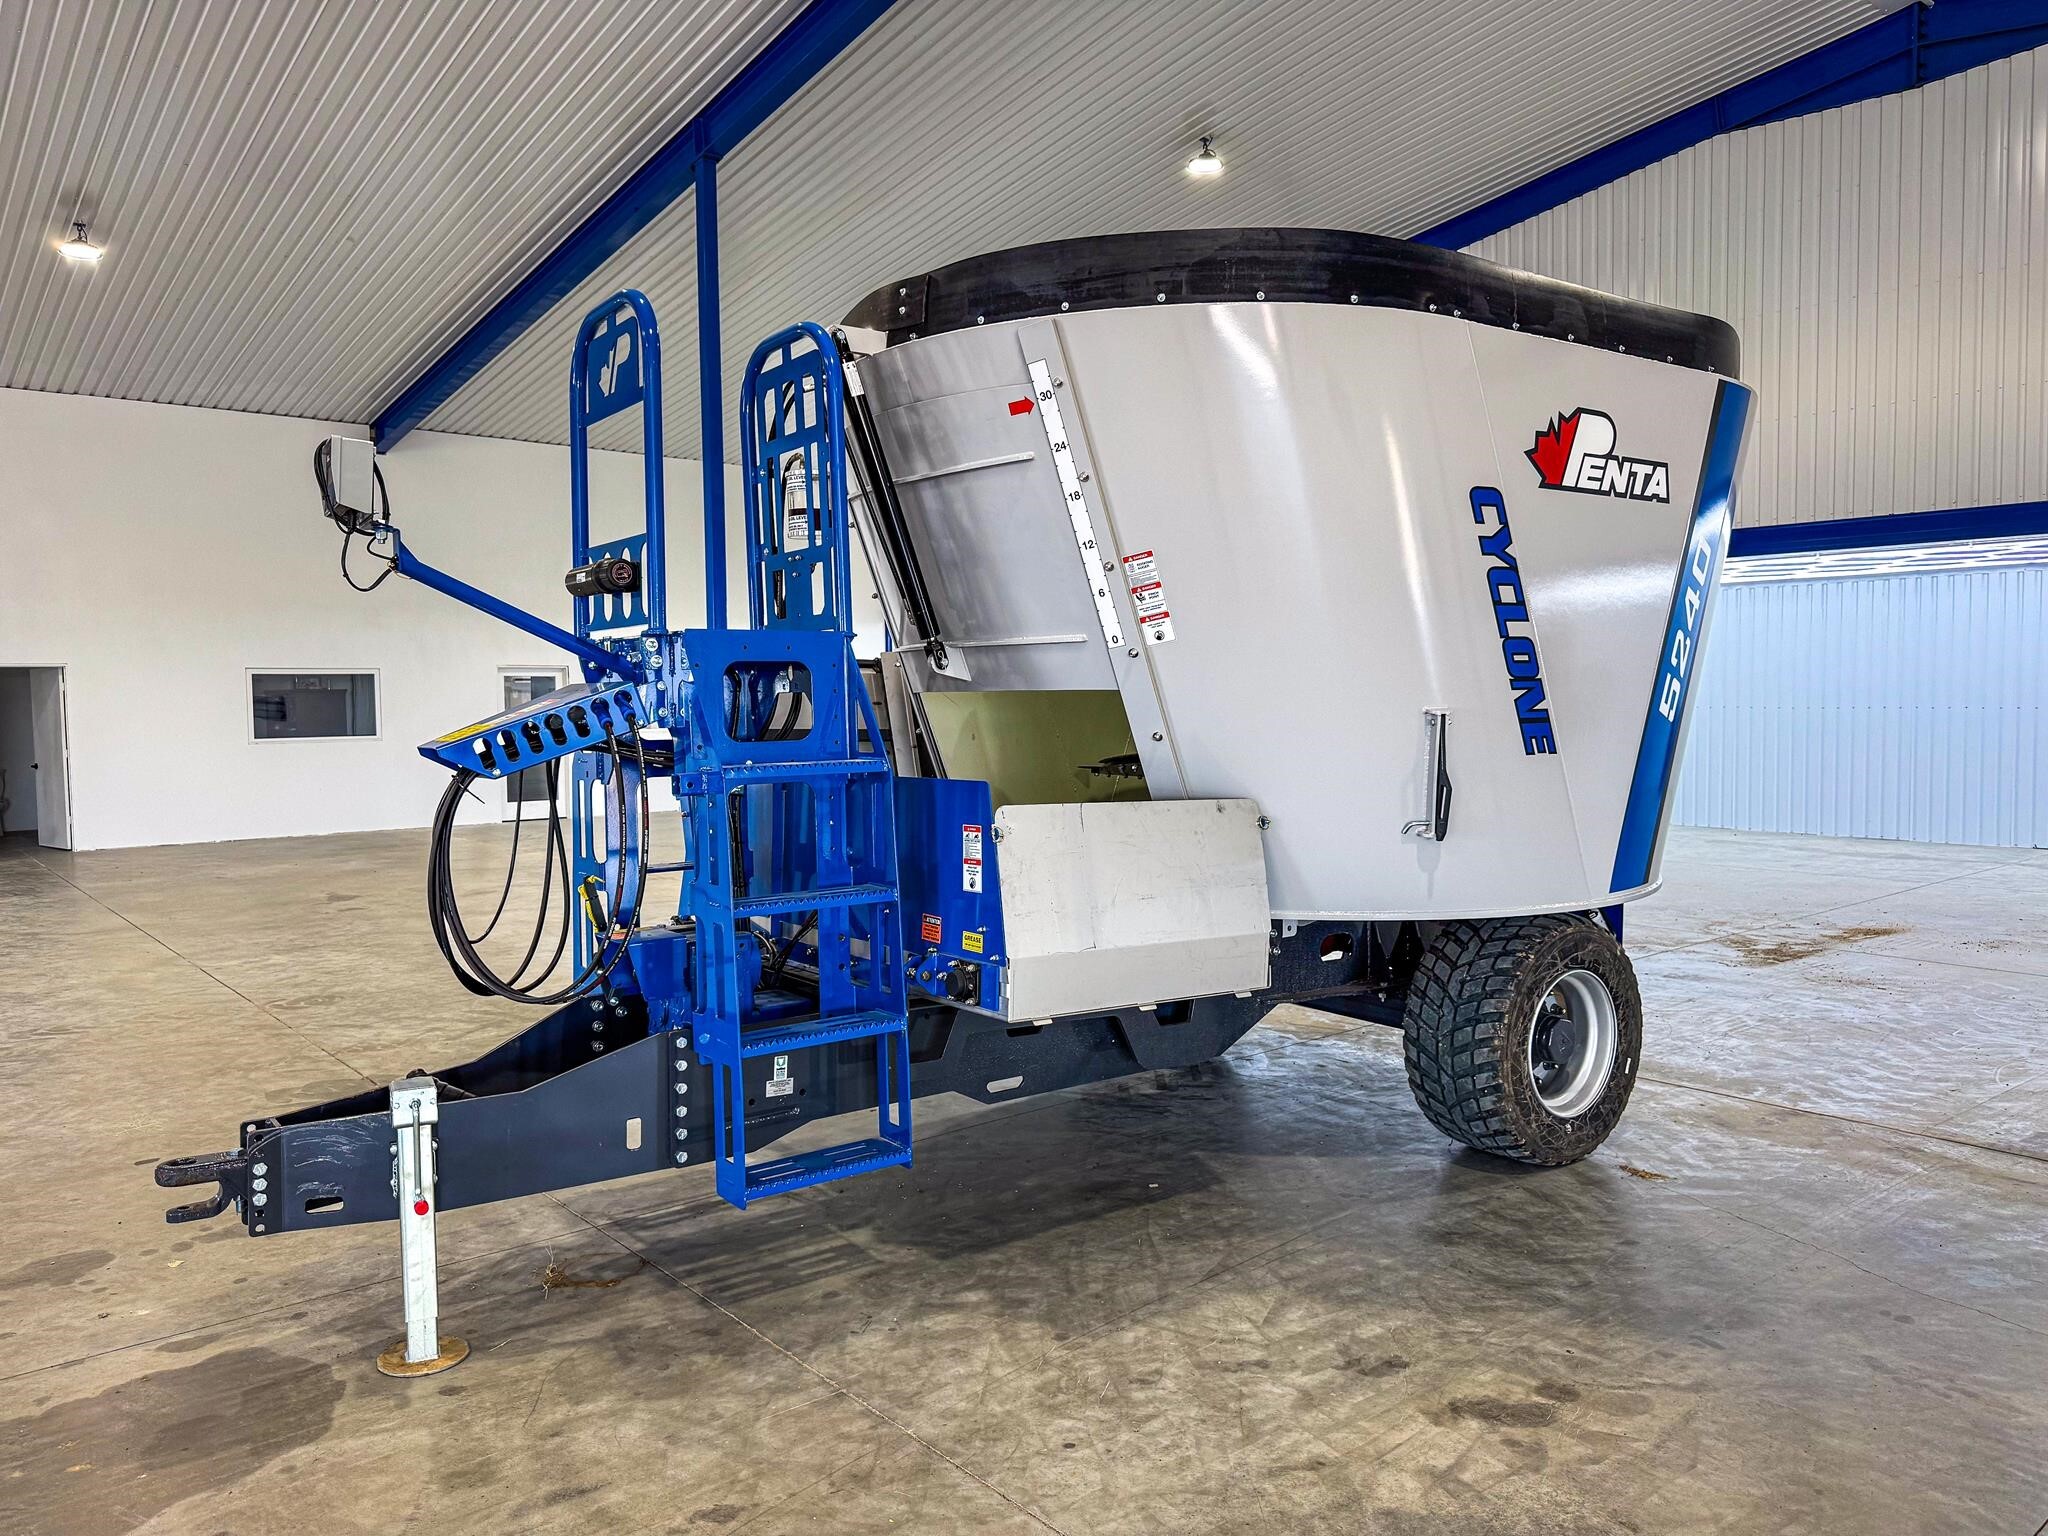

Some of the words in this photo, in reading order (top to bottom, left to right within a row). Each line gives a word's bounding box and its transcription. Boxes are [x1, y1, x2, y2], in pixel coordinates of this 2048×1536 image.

[1039, 390, 1053, 401] 30
[1054, 441, 1067, 452] 24
[1560, 407, 1671, 504] PENTA
[1068, 490, 1081, 501] 18
[1081, 539, 1095, 550] 12
[1098, 588, 1105, 598] 6
[1469, 485, 1557, 756] CYCLONE
[1111, 635, 1119, 645] 0
[964, 934, 982, 944] GREASE
